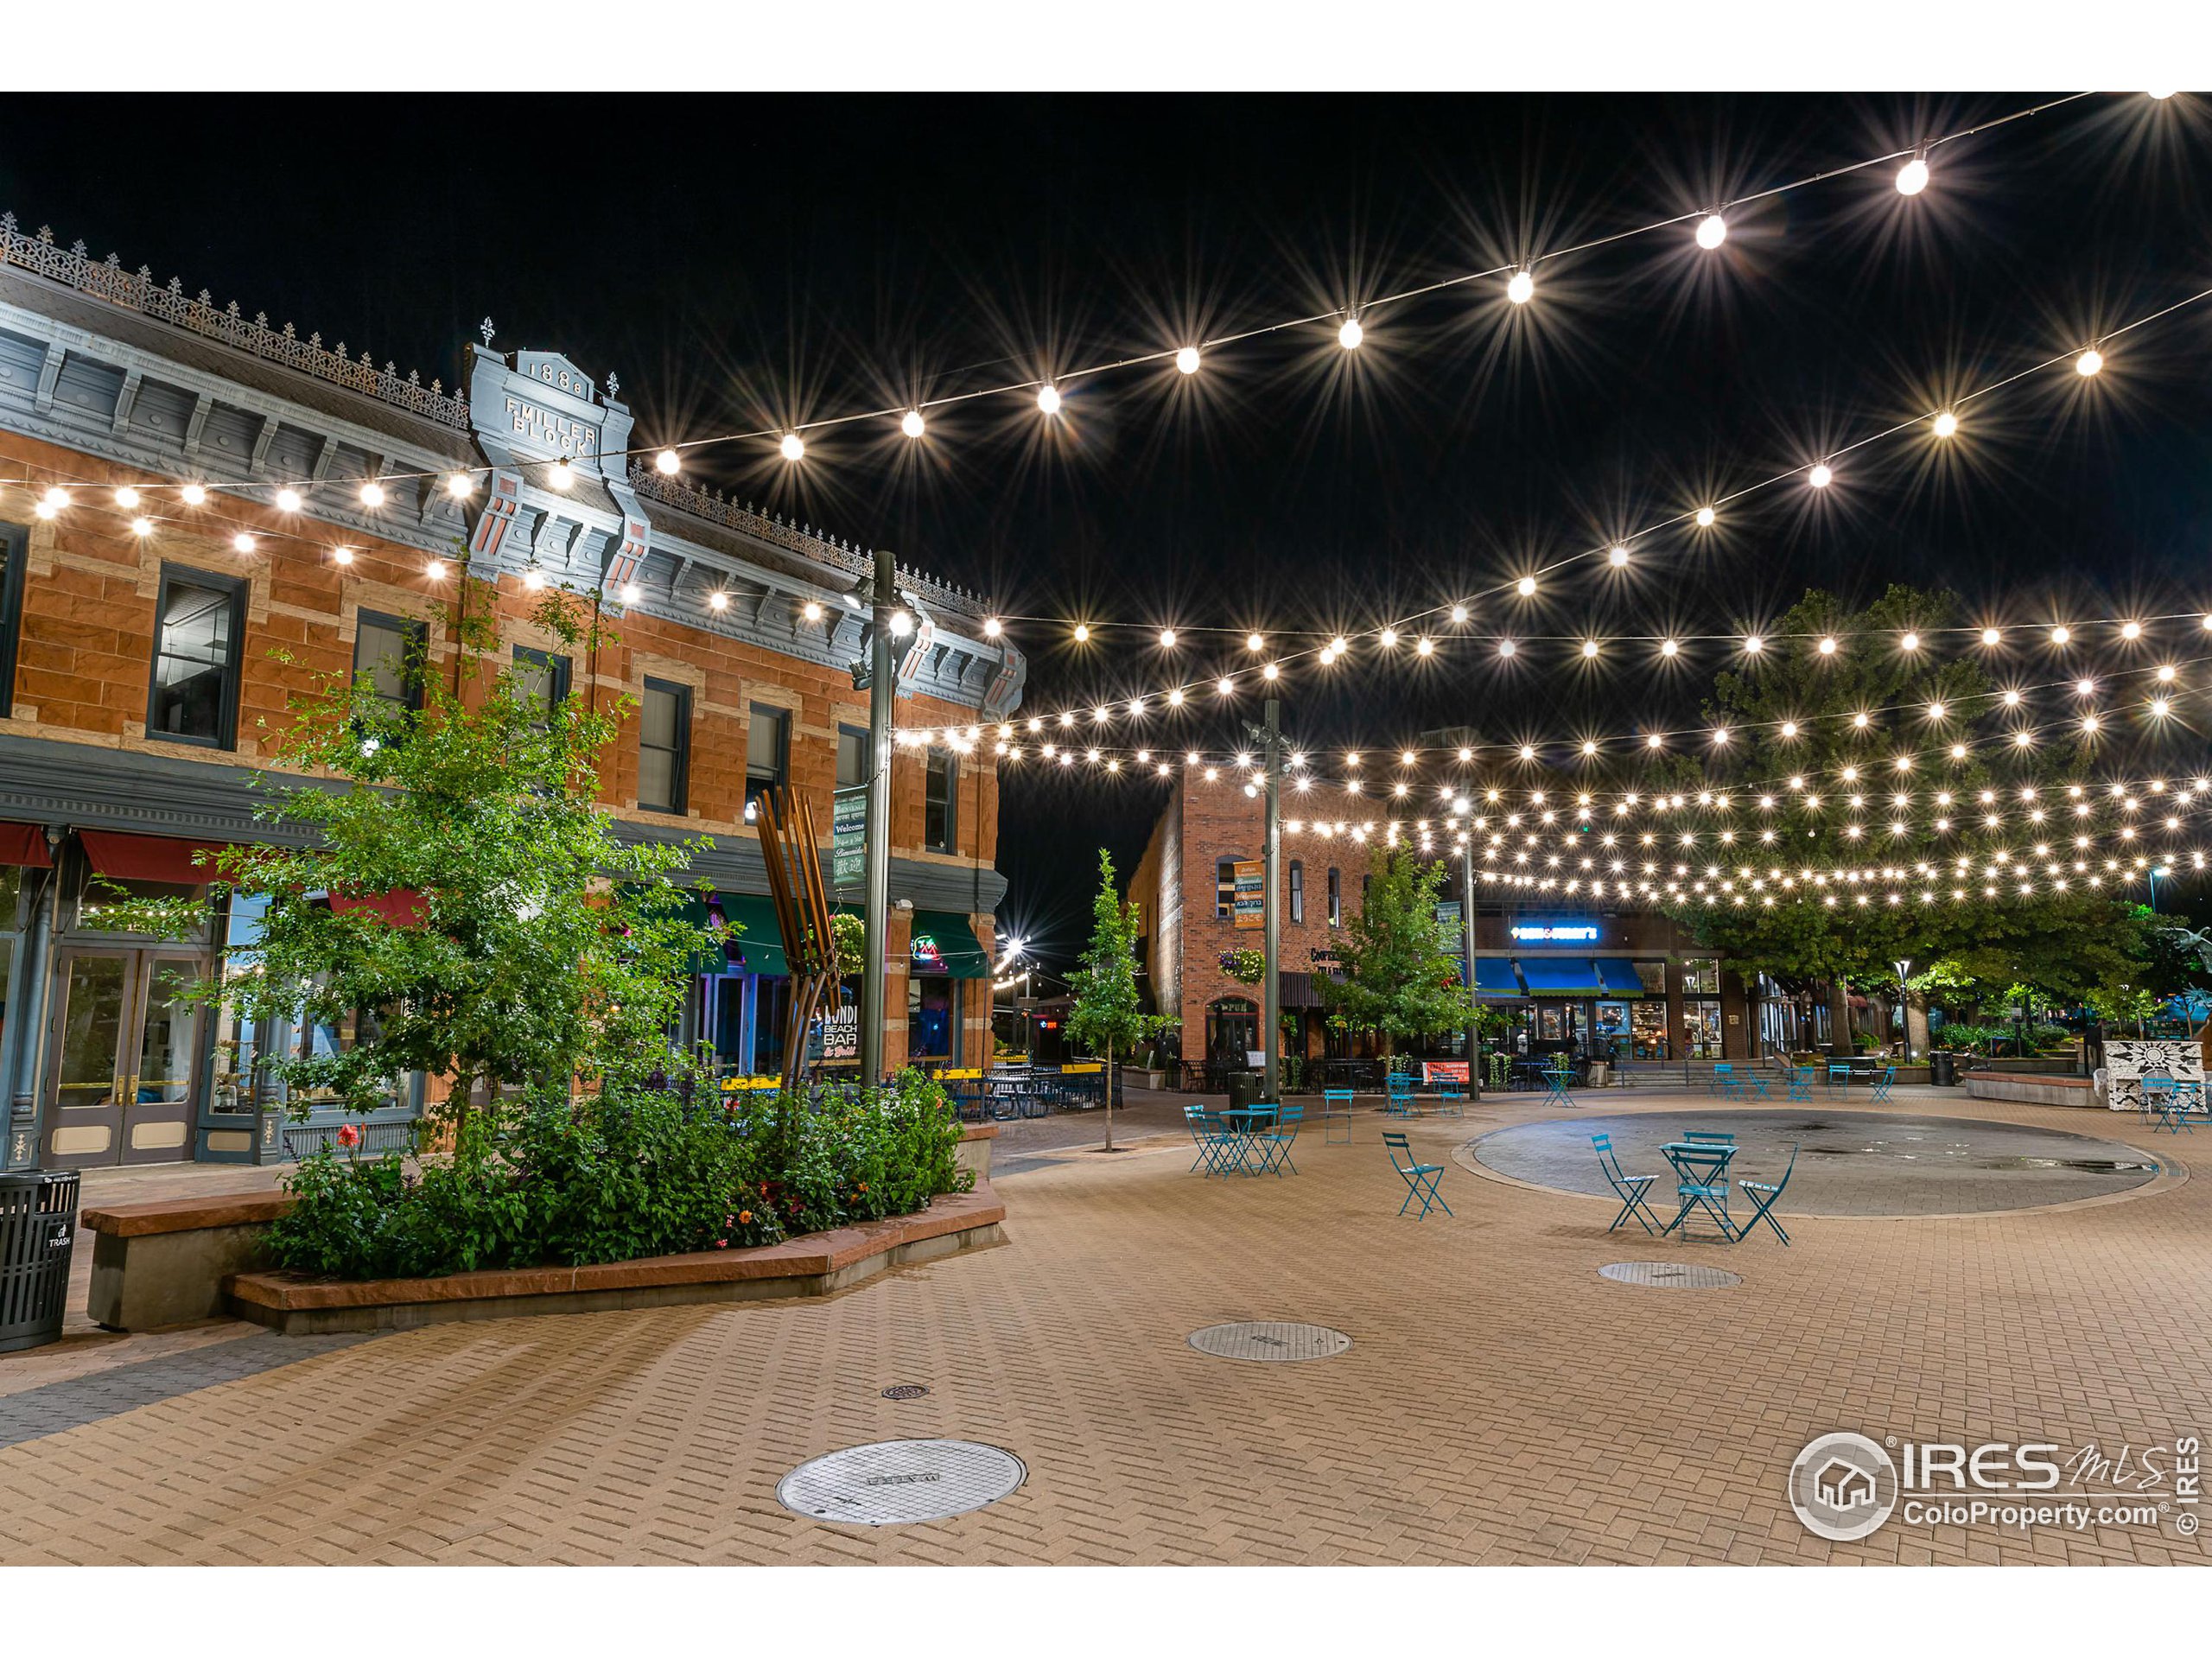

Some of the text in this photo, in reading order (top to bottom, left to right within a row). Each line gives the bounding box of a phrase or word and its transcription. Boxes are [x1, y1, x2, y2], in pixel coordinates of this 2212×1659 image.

[530, 363, 582, 393] 1888
[512, 416, 587, 457] BLOCK
[836, 824, 864, 833] Welcome
[824, 1033, 857, 1046] BAR
[49, 1237, 71, 1248] TRASH
